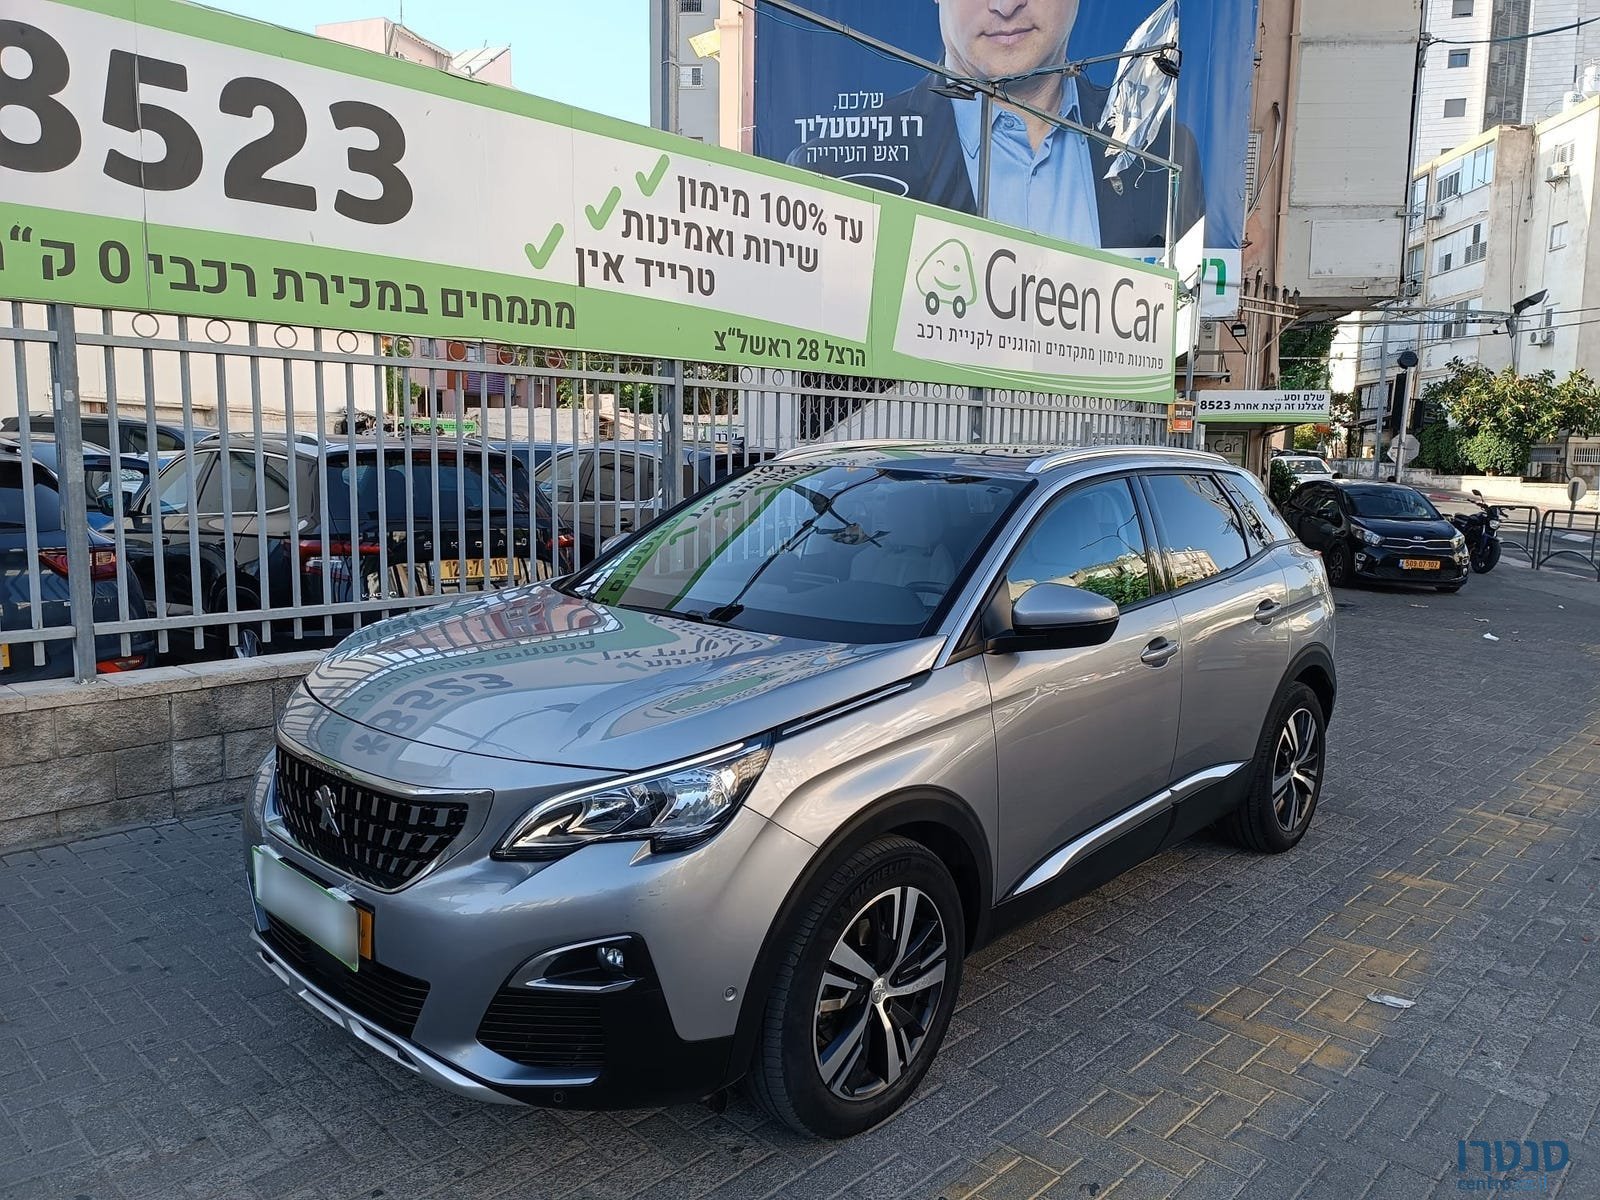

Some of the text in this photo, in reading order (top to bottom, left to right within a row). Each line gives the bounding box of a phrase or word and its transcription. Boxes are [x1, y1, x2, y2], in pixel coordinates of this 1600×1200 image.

[832, 90, 884, 111] שלכם,
[0, 19, 413, 225] 8523
[794, 114, 923, 143] רז קינסטליך
[807, 145, 909, 164] ראש העירייה
[678, 174, 863, 244] עד 100% מימון
[621, 207, 818, 273] שירות ואמינות
[98, 239, 131, 284] 0
[148, 253, 257, 298] רכבי
[575, 247, 716, 296] טרייד אין
[273, 267, 429, 315] במכירת
[985, 249, 1164, 343] Green Car
[441, 287, 575, 329] מתמחים
[797, 337, 820, 361] 28
[825, 339, 866, 367] הרצל
[917, 322, 1164, 369] פתרונות מימון מתקדמים והוגנים לקניית רכב
[1233, 402, 1259, 410] אחרת
[1261, 402, 1282, 412] קצת
[1284, 402, 1295, 410] זה
[1298, 402, 1324, 411] אצלנו
[1303, 393, 1325, 401] שלם
[1214, 439, 1240, 453] Car
